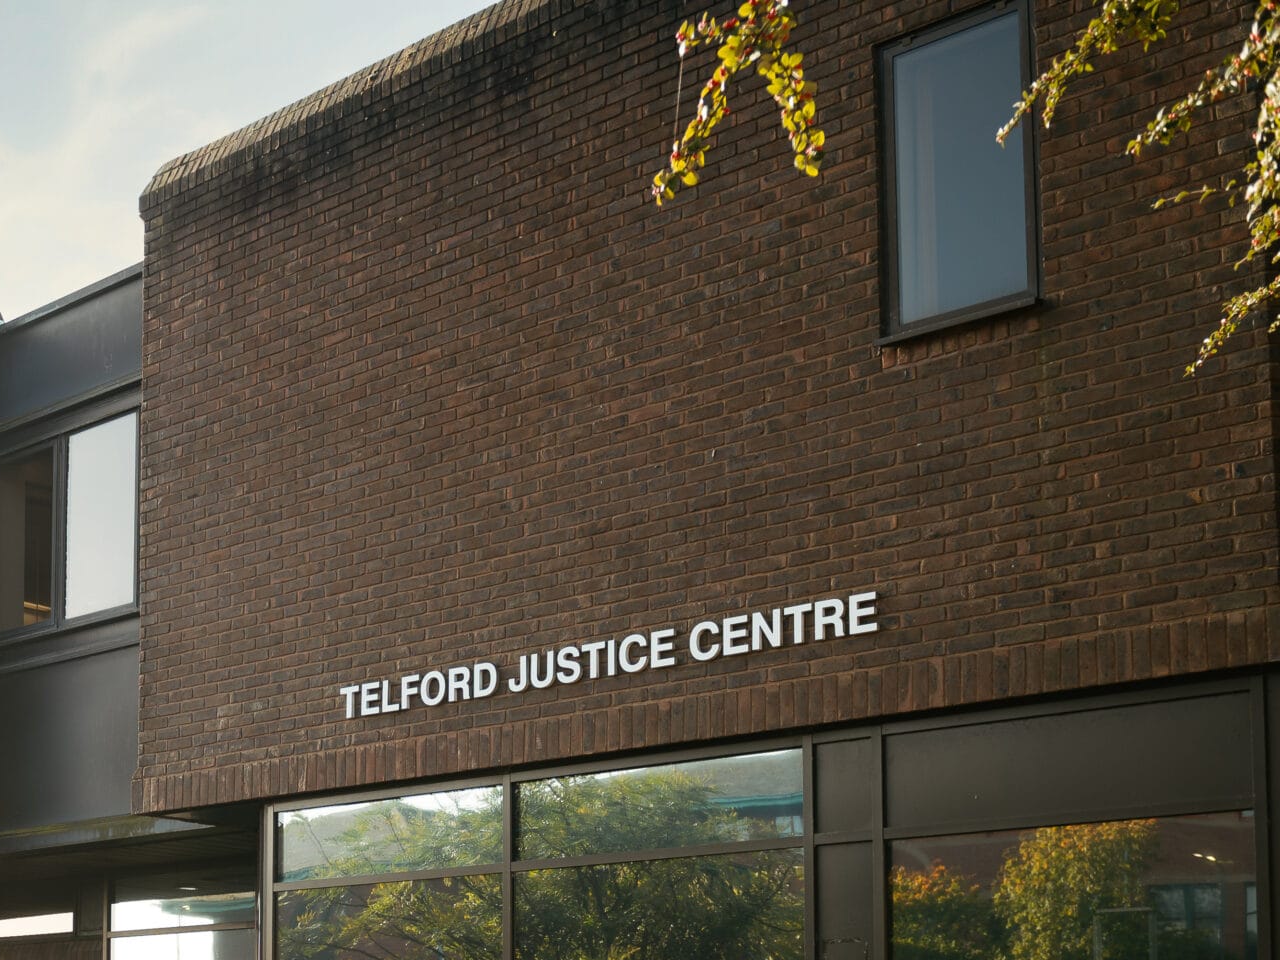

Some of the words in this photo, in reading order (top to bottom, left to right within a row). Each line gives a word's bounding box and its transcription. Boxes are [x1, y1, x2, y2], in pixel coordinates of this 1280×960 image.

[339, 662, 498, 719] TELFORD
[508, 628, 676, 692] JUSTICE
[688, 591, 879, 662] CENTRE
